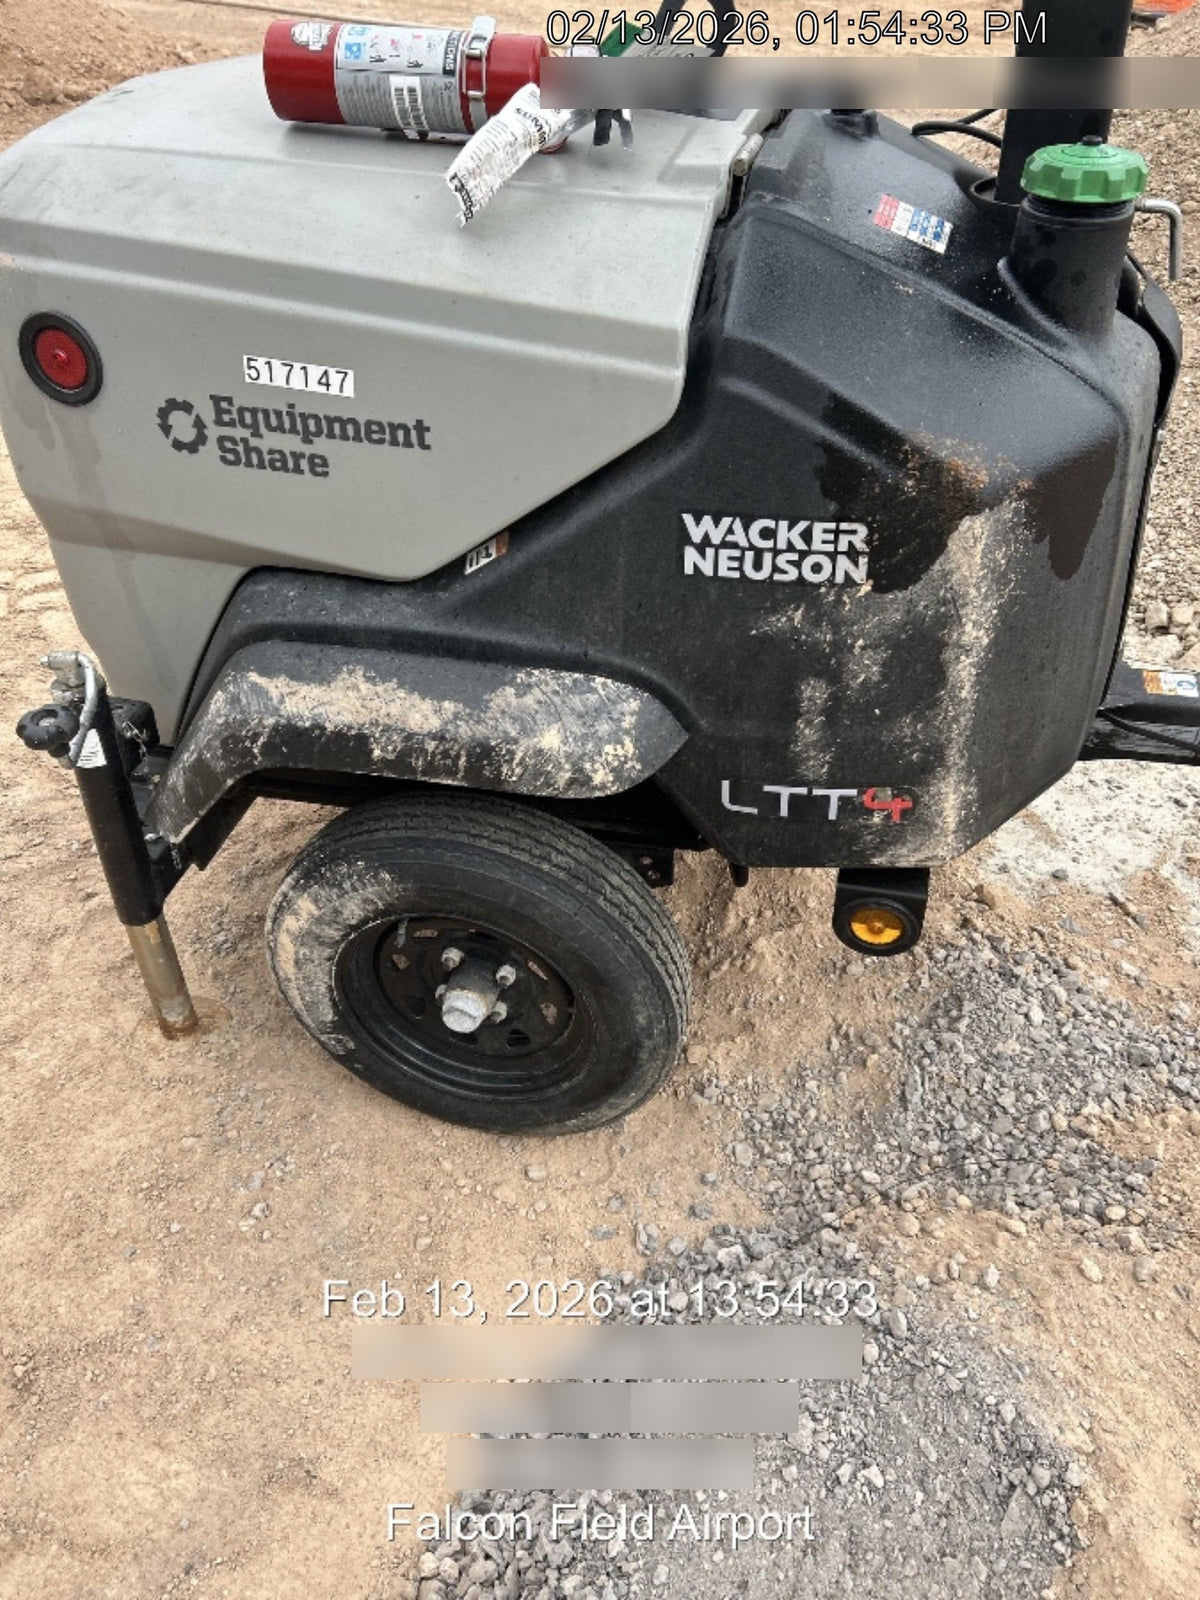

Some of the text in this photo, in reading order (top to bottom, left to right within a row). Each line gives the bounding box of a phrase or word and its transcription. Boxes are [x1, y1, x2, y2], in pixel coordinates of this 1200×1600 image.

[244, 356, 350, 393] 517147
[210, 394, 432, 450] Equipment
[216, 435, 330, 477] Share
[681, 512, 870, 552] WACKER
[683, 545, 869, 584] NEUSON
